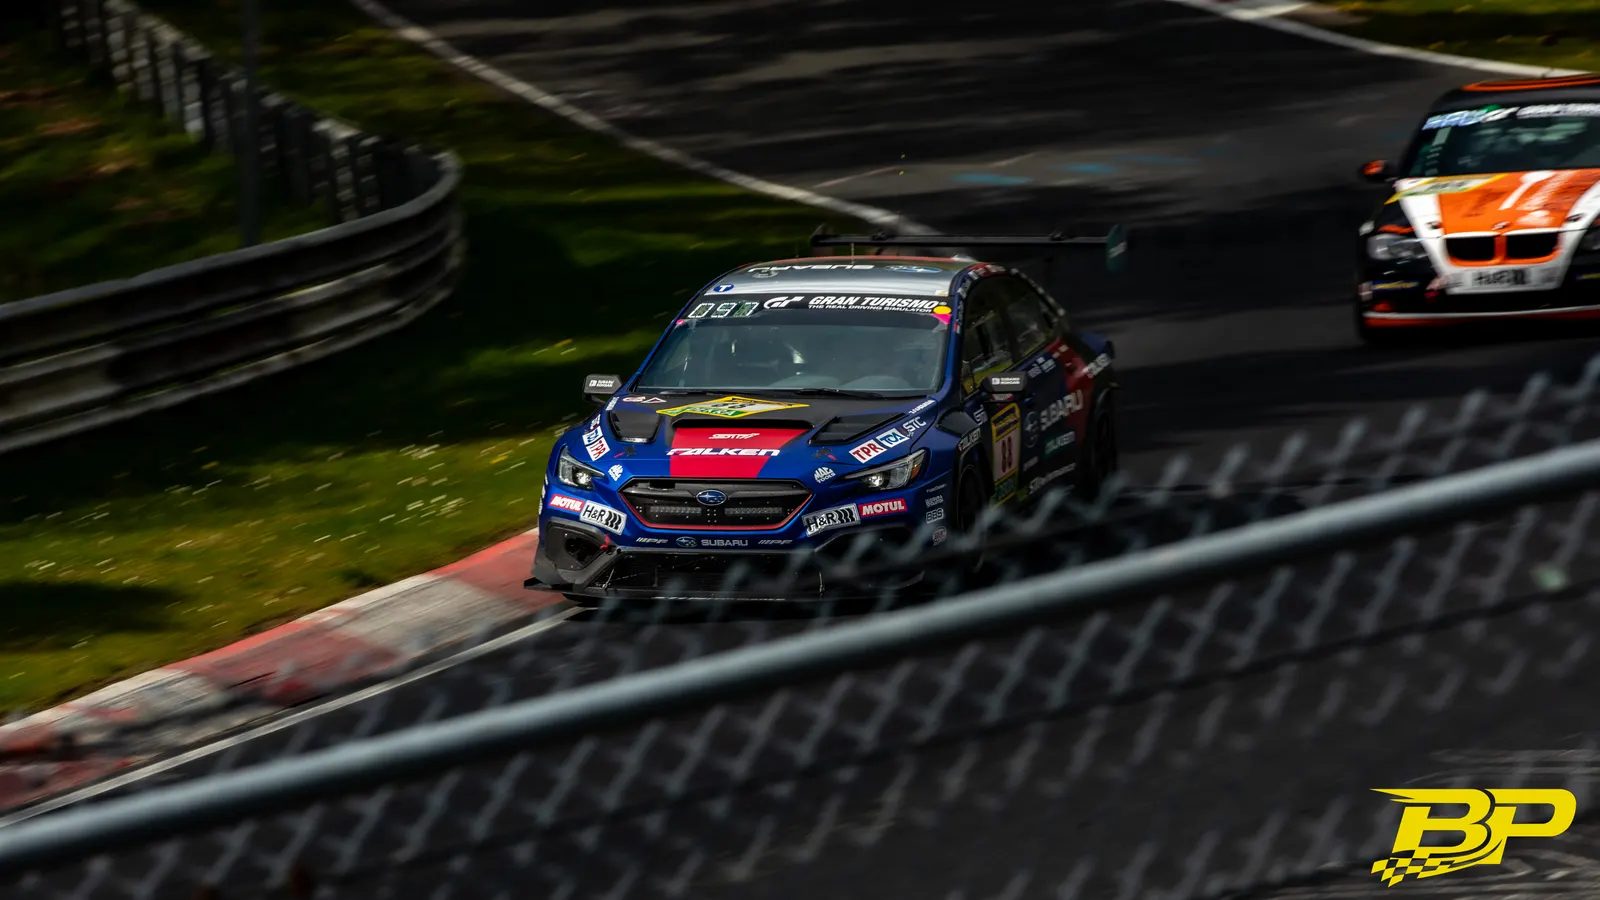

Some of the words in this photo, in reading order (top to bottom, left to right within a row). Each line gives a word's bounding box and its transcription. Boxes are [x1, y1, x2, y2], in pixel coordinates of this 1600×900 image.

[808, 296, 861, 305] GRAN
[861, 297, 939, 309] TURISMO
[1039, 389, 1084, 431] SUBARU
[902, 416, 927, 432] STC
[666, 448, 781, 457] FALKEN
[852, 443, 884, 461] TPR
[814, 466, 834, 481] MAC
[816, 473, 836, 484] TOOLS
[550, 495, 584, 512] MOTUL
[861, 500, 905, 516] MOTUL
[582, 504, 606, 524] H&R
[805, 512, 837, 532] H&R
[926, 508, 944, 523] BBS
